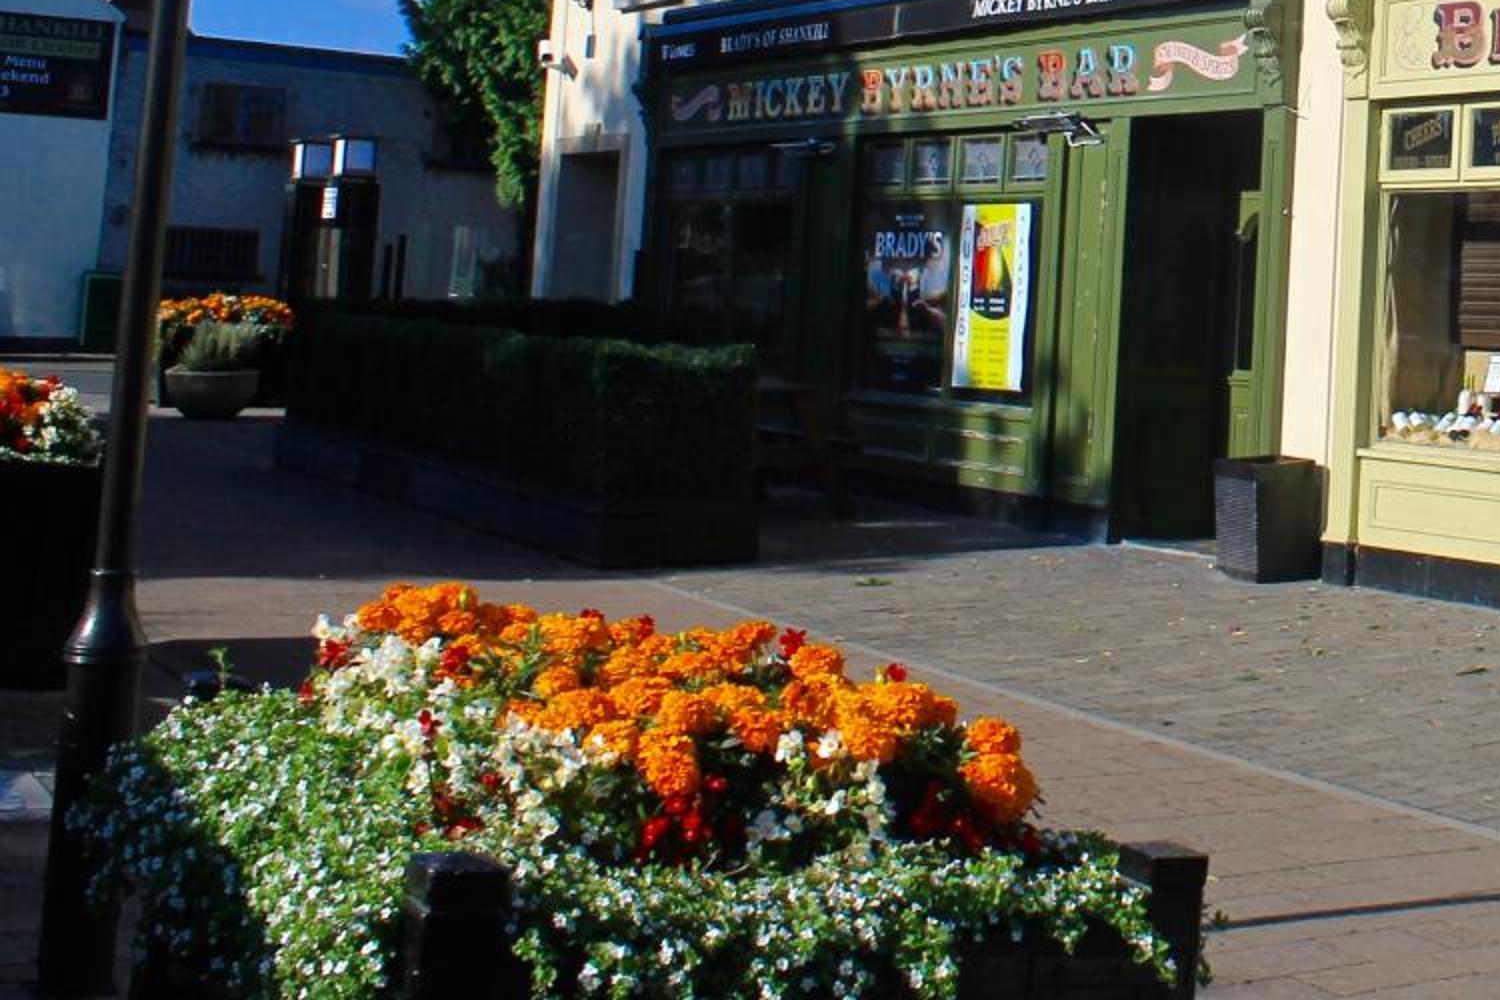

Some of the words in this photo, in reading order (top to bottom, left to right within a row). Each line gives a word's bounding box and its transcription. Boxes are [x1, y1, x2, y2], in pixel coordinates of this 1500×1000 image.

[727, 72, 851, 121] MICKEY
[861, 53, 1024, 113] BYRNE'S
[1037, 44, 1139, 102] BAR
[875, 230, 943, 258] BRADY'S
